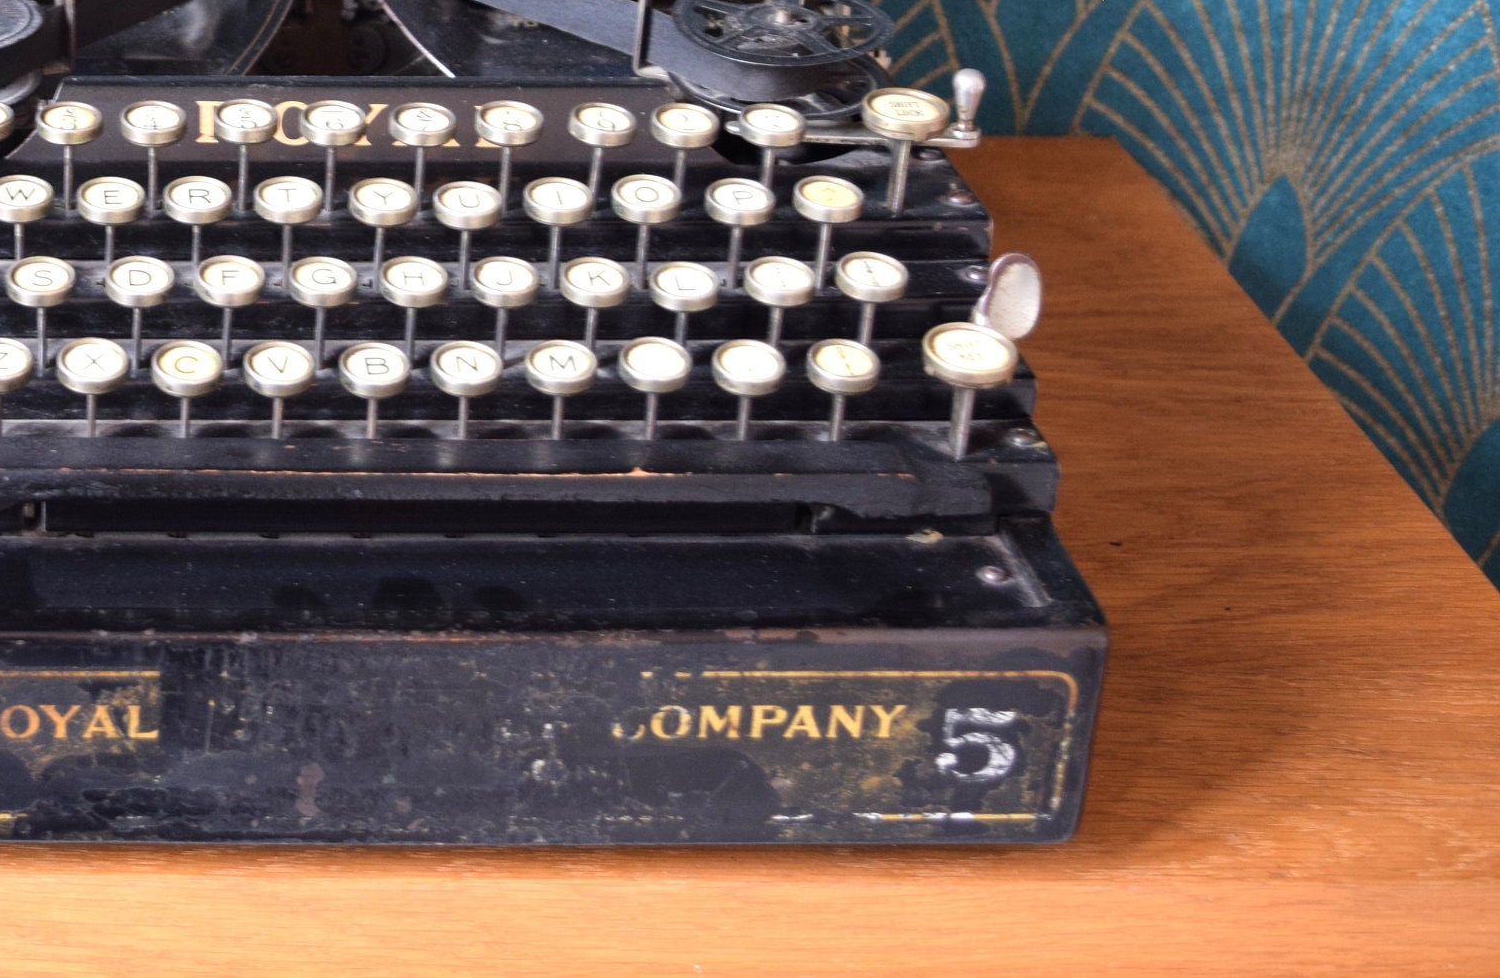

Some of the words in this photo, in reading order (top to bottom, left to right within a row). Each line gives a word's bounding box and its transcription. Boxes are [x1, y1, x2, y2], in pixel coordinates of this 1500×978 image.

[5, 187, 36, 201] W
[103, 189, 123, 204] E
[188, 188, 212, 204] R
[277, 188, 297, 202] T
[373, 190, 394, 205] Y
[458, 193, 481, 209] U
[634, 186, 659, 202] O
[732, 190, 754, 205] P
[33, 269, 53, 287] S
[128, 269, 152, 286] D
[221, 270, 241, 286] F
[311, 268, 336, 285] G
[403, 270, 424, 286] H
[496, 269, 514, 286] J
[587, 270, 611, 286] K
[674, 275, 696, 291] L
[82, 353, 105, 371] X
[174, 356, 200, 374] C
[267, 356, 291, 374] V
[364, 357, 389, 375] B
[456, 355, 478, 372] N
[550, 355, 577, 372] M
[936, 707, 1017, 781] 5
